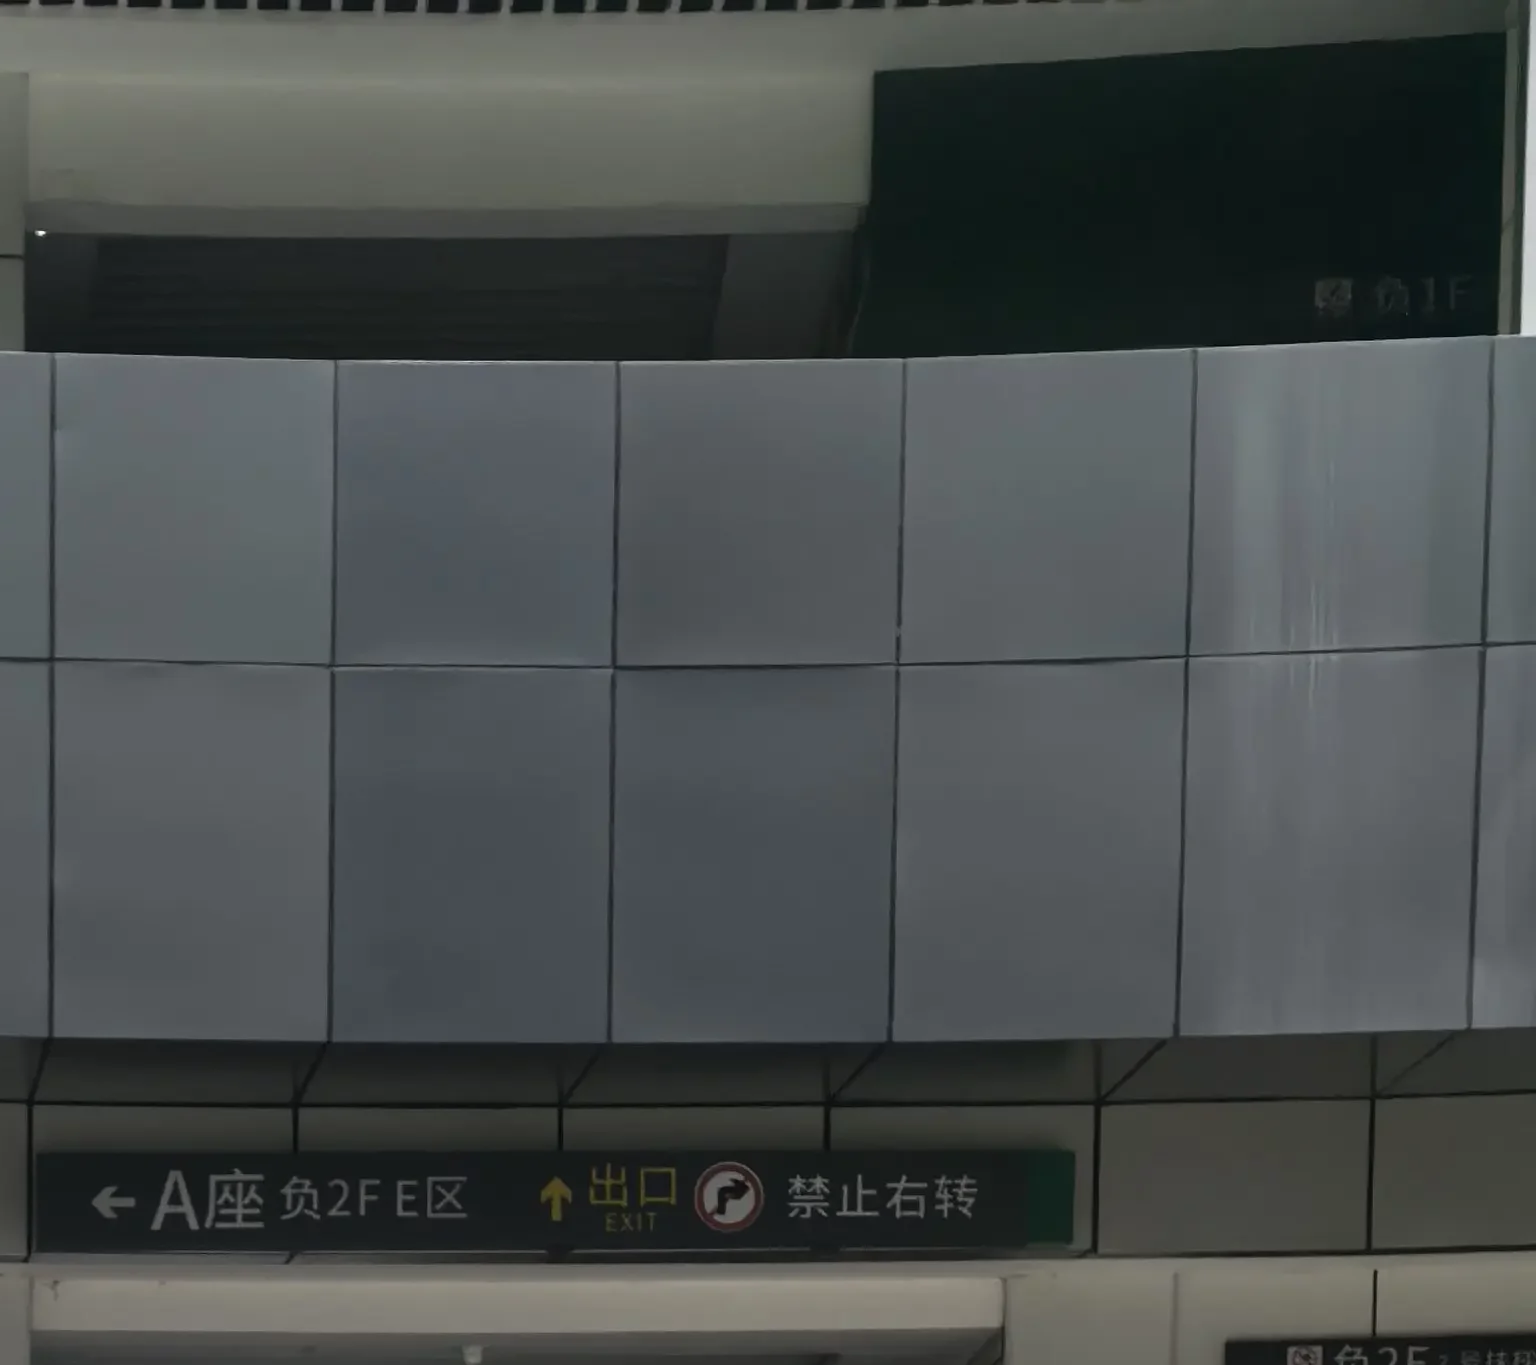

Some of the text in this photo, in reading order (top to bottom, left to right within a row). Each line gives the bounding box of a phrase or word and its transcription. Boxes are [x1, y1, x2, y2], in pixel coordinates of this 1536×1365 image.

[150, 1167, 266, 1231] A座
[588, 1162, 678, 1209] 出口
[787, 1173, 979, 1221] 禁止右转
[604, 1212, 658, 1233] EXIT
